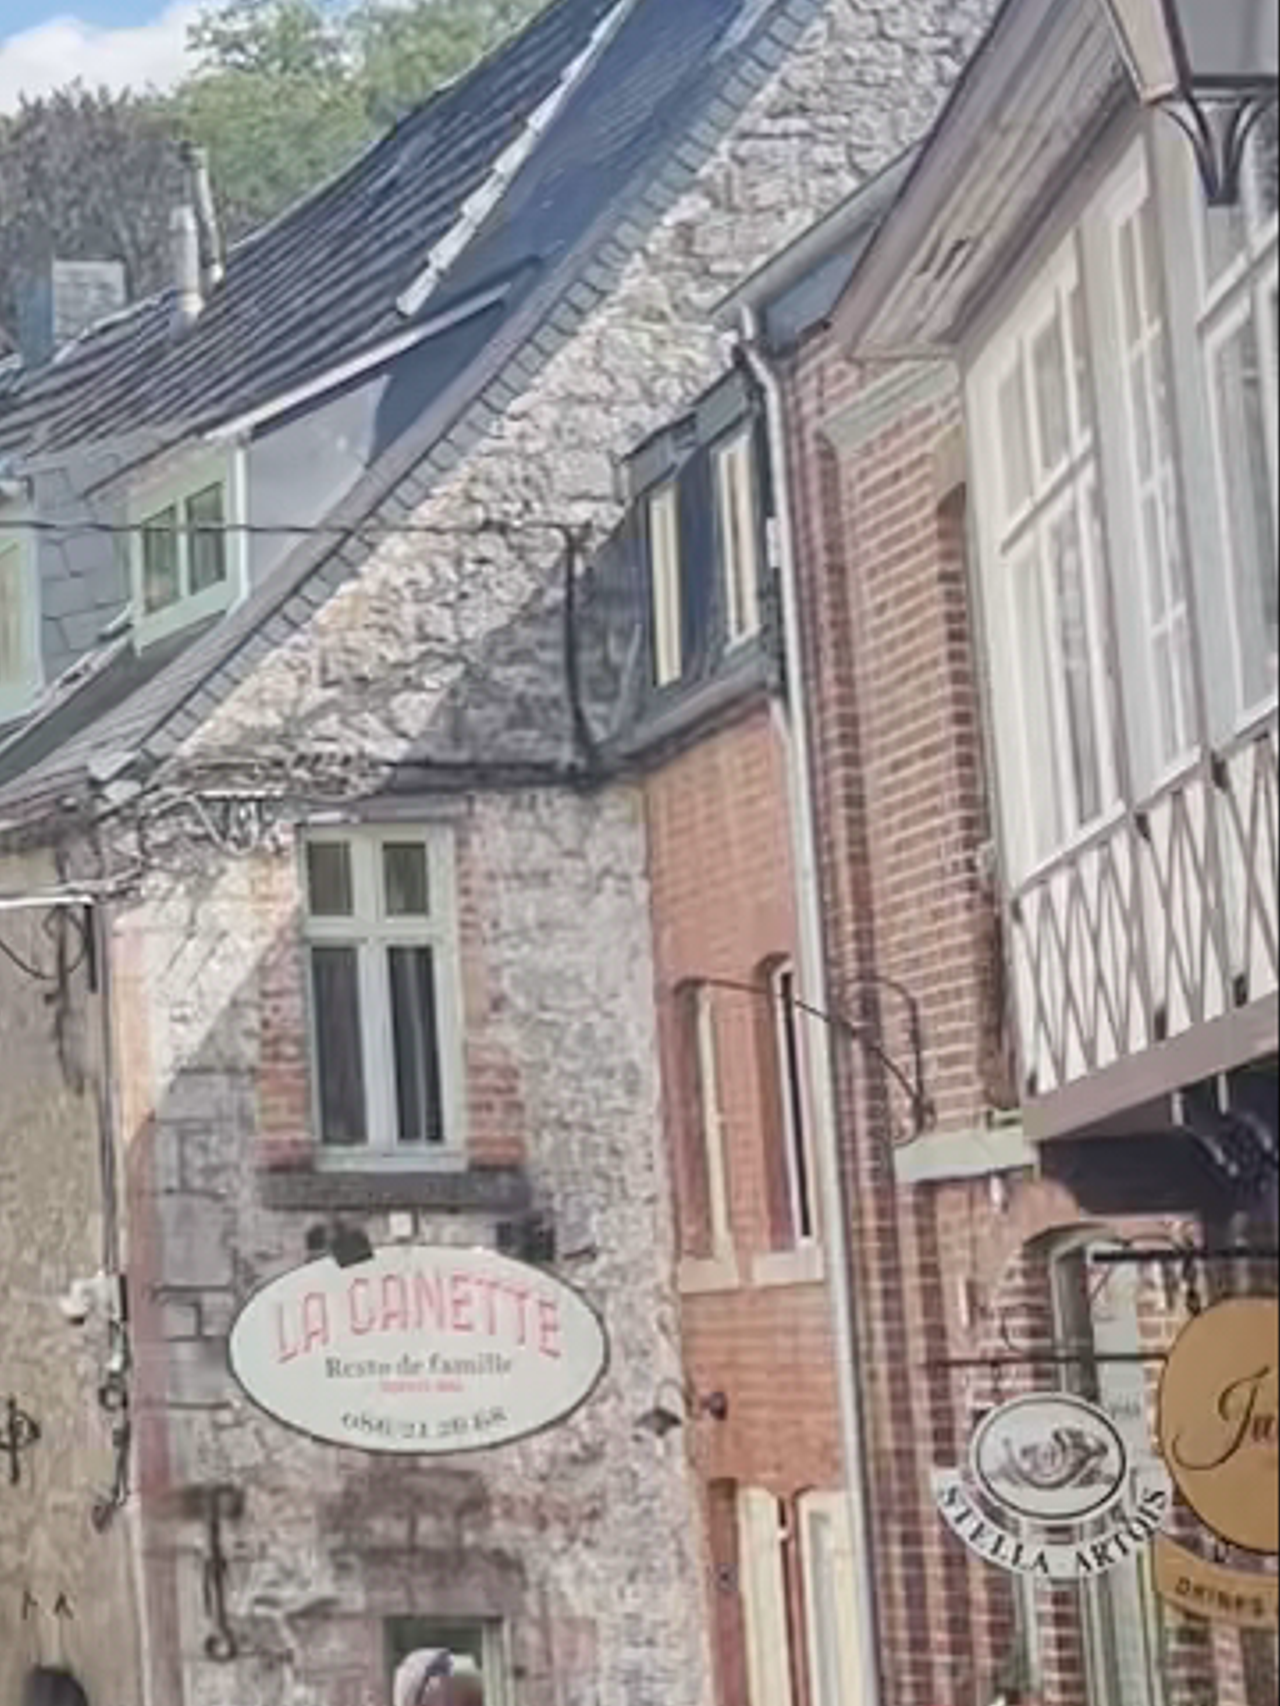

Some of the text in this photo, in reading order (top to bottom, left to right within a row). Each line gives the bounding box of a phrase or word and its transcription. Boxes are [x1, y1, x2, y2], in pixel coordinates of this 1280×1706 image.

[276, 1273, 561, 1363] LA CANETTE
[396, 1351, 424, 1376] de
[941, 1486, 1166, 1574] STELLA ARTOIS
